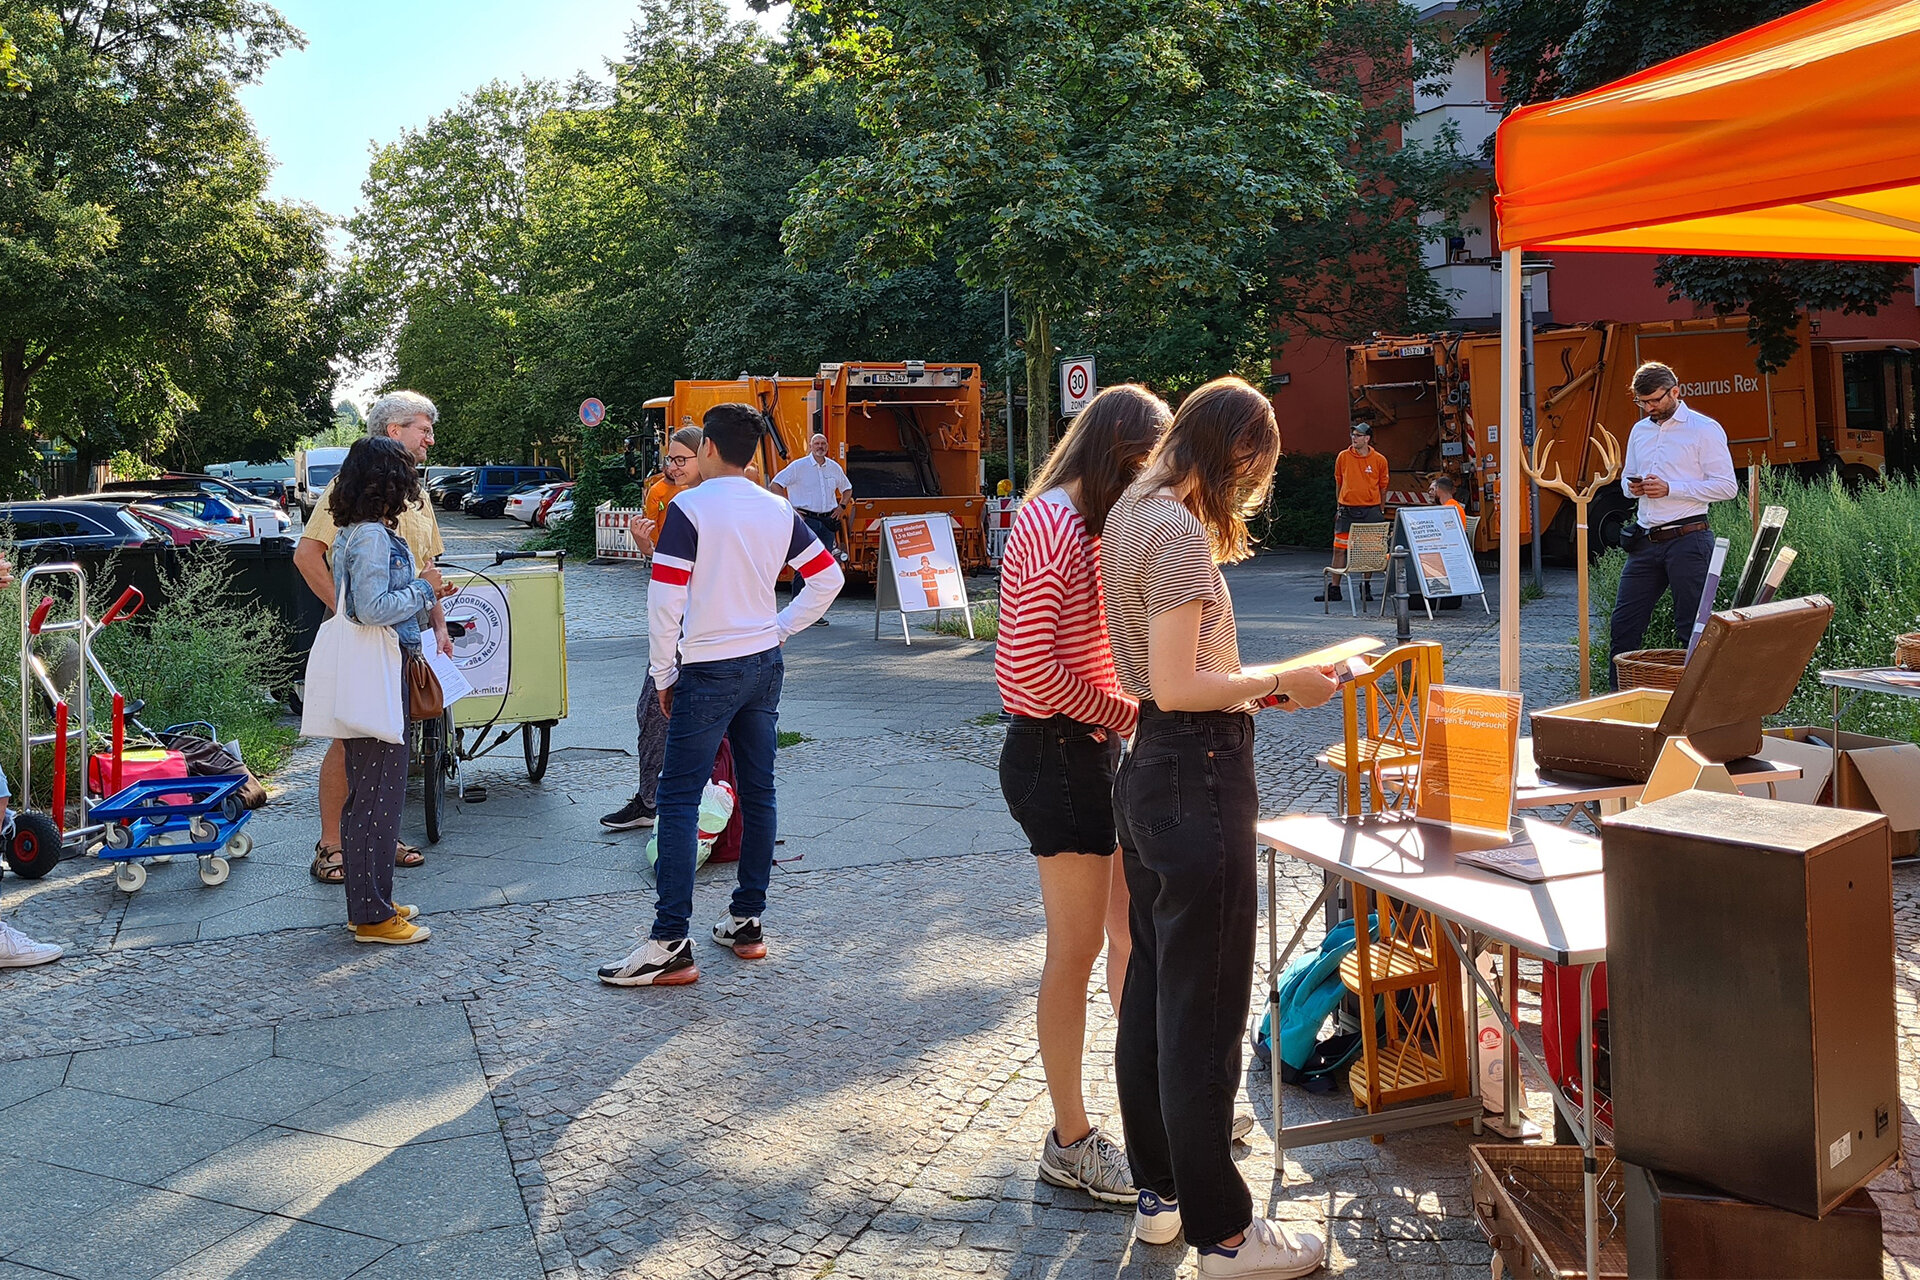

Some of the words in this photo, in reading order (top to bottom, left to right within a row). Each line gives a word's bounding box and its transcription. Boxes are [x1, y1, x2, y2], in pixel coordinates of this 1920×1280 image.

[1072, 374, 1084, 390] 30
[1679, 379, 1731, 397] osaurus
[1734, 374, 1759, 393] Rex
[443, 597, 499, 627] EILKOORDINATION
[465, 657, 482, 667] raße
[482, 641, 496, 658] Nord
[467, 686, 504, 695] tk-mitte
[1436, 705, 1466, 715] Tausche
[1468, 708, 1508, 720] Niegewollt
[1434, 717, 1458, 726] gegen
